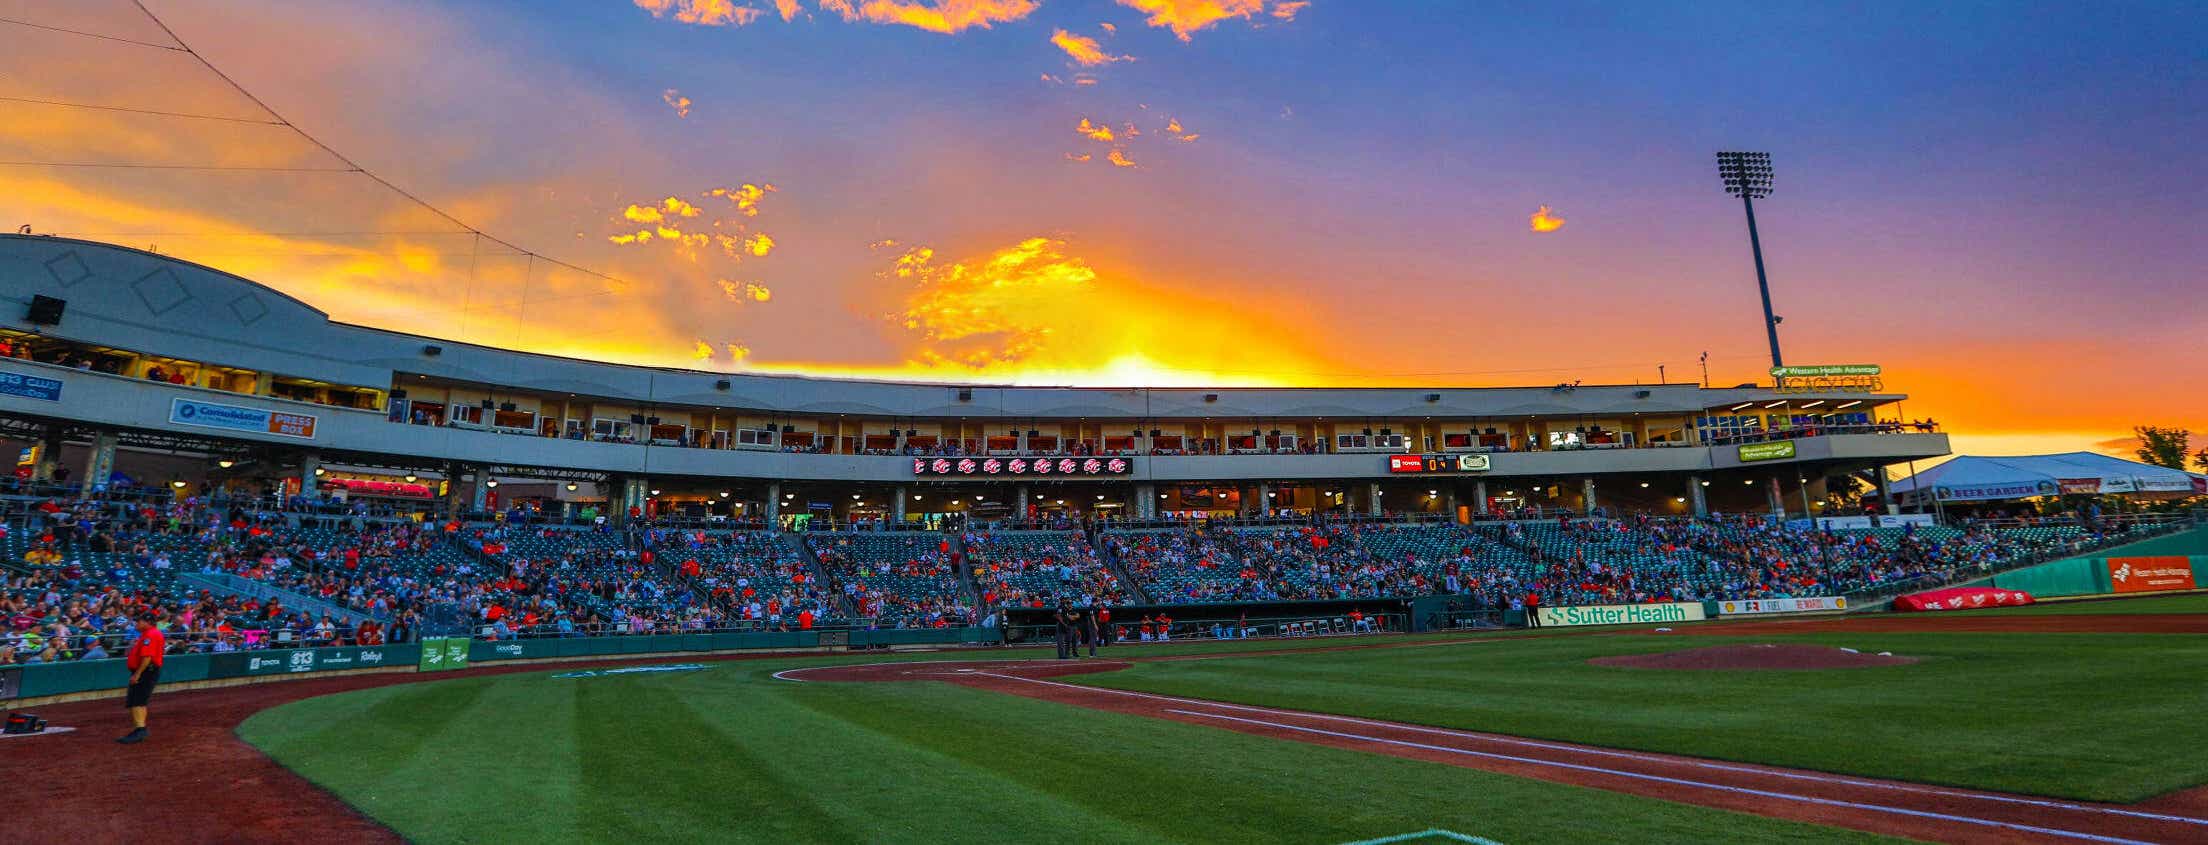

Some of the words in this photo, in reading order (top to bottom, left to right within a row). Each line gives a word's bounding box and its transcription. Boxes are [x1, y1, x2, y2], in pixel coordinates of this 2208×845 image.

[1789, 367, 1819, 375] Western
[1820, 367, 1843, 375] Health
[1844, 366, 1879, 375] Advantage
[199, 406, 266, 421] Consolidated
[274, 414, 312, 427] PRESS
[280, 424, 305, 435] BOX
[1429, 459, 1437, 471] 0
[1954, 488, 1985, 498] BEER
[1986, 486, 2034, 496] GARDEN
[1567, 606, 1624, 625] Sutter
[1627, 604, 1686, 622] Health
